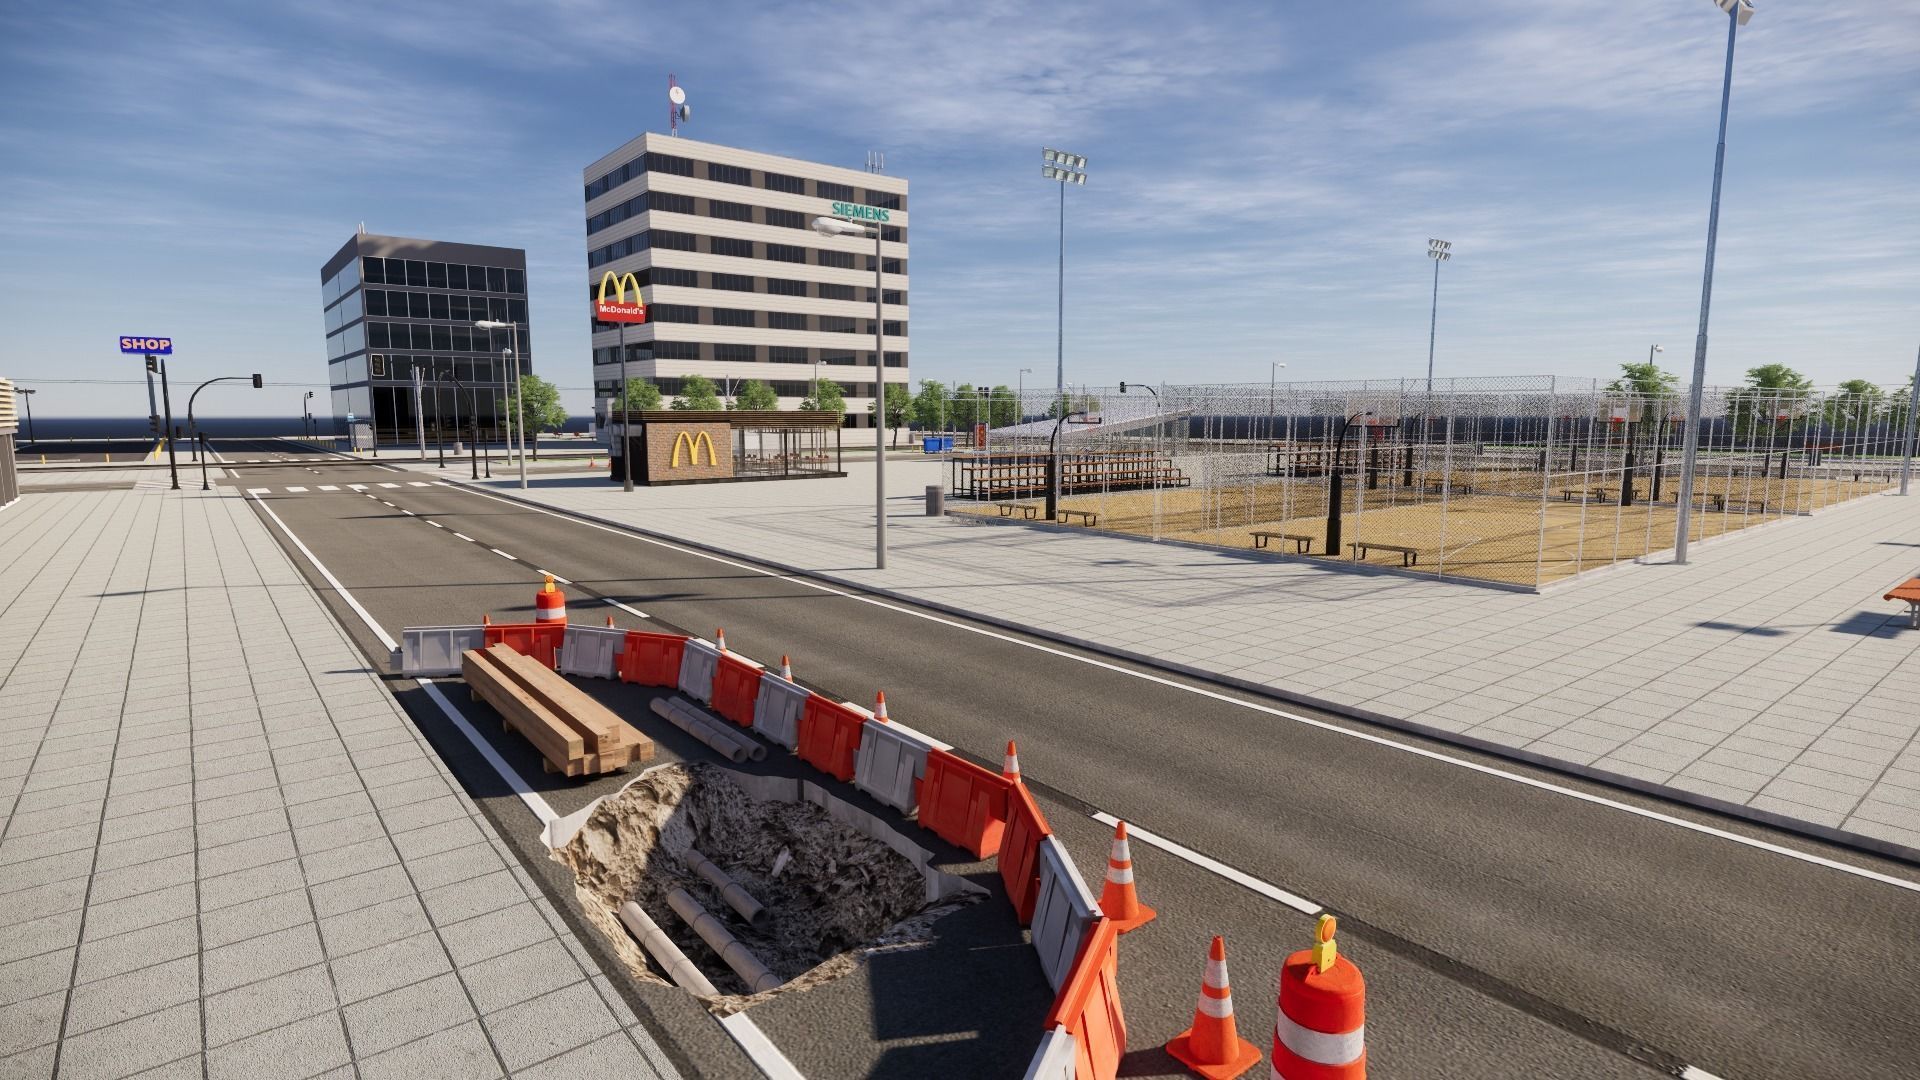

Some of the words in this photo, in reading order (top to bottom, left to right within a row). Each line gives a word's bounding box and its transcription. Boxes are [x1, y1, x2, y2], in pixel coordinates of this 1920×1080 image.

[832, 201, 889, 222] SIEMENS
[600, 305, 644, 315] McDonald's
[121, 338, 170, 350] SHOP
